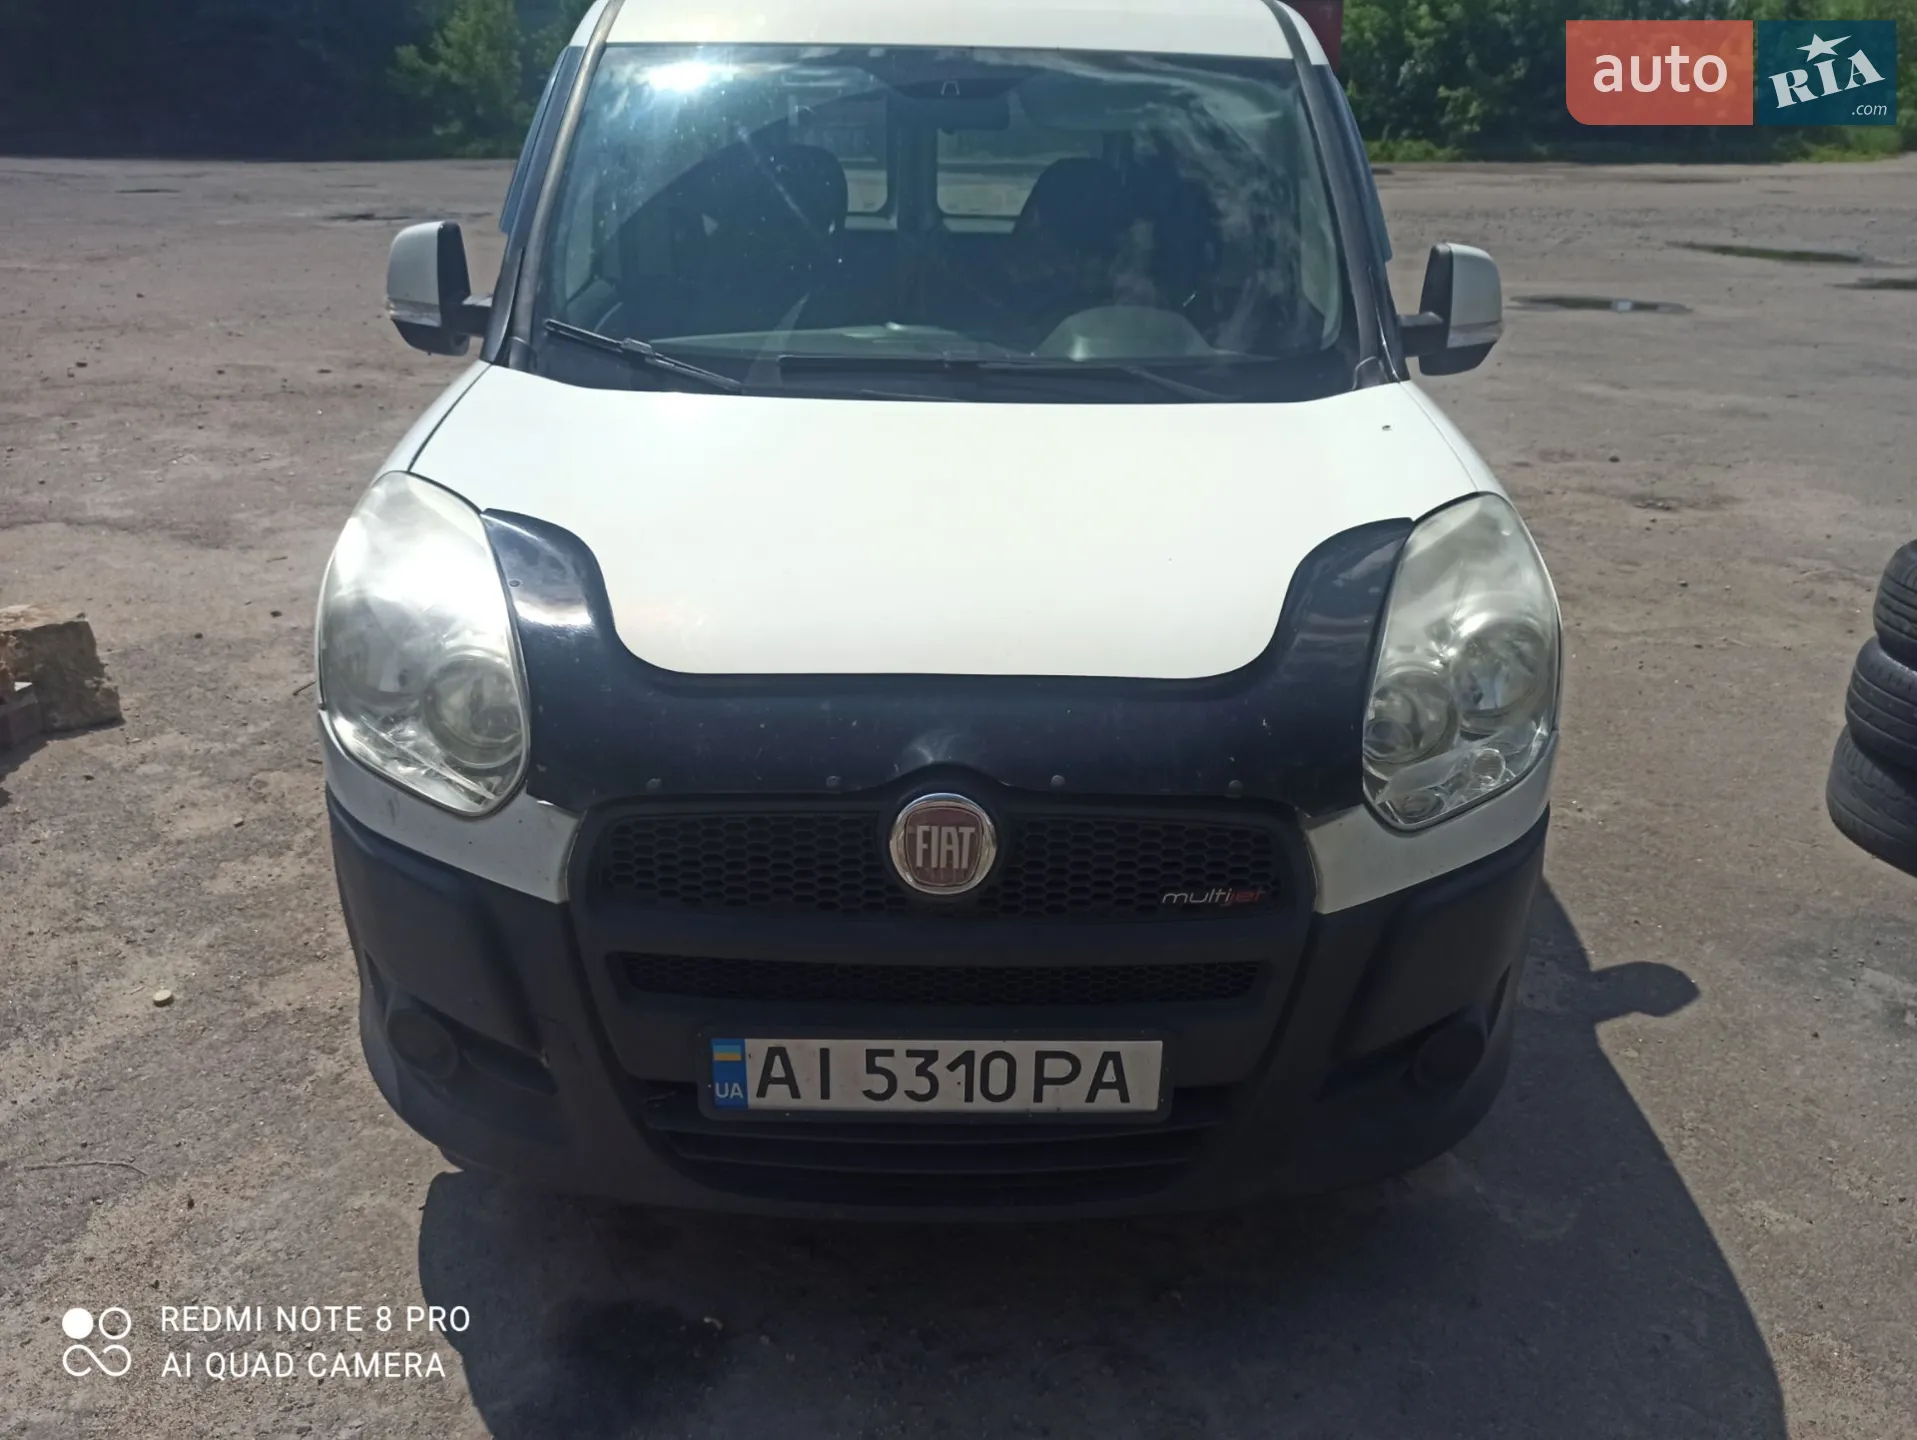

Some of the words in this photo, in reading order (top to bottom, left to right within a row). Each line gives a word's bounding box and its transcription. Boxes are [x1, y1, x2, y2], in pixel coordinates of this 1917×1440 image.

[915, 825, 976, 870] FIAT
[1161, 886, 1266, 907] multijet
[714, 1082, 744, 1100] UA
[755, 1046, 831, 1101] AI
[861, 1048, 1018, 1104] 5310
[1032, 1050, 1131, 1104] PA
